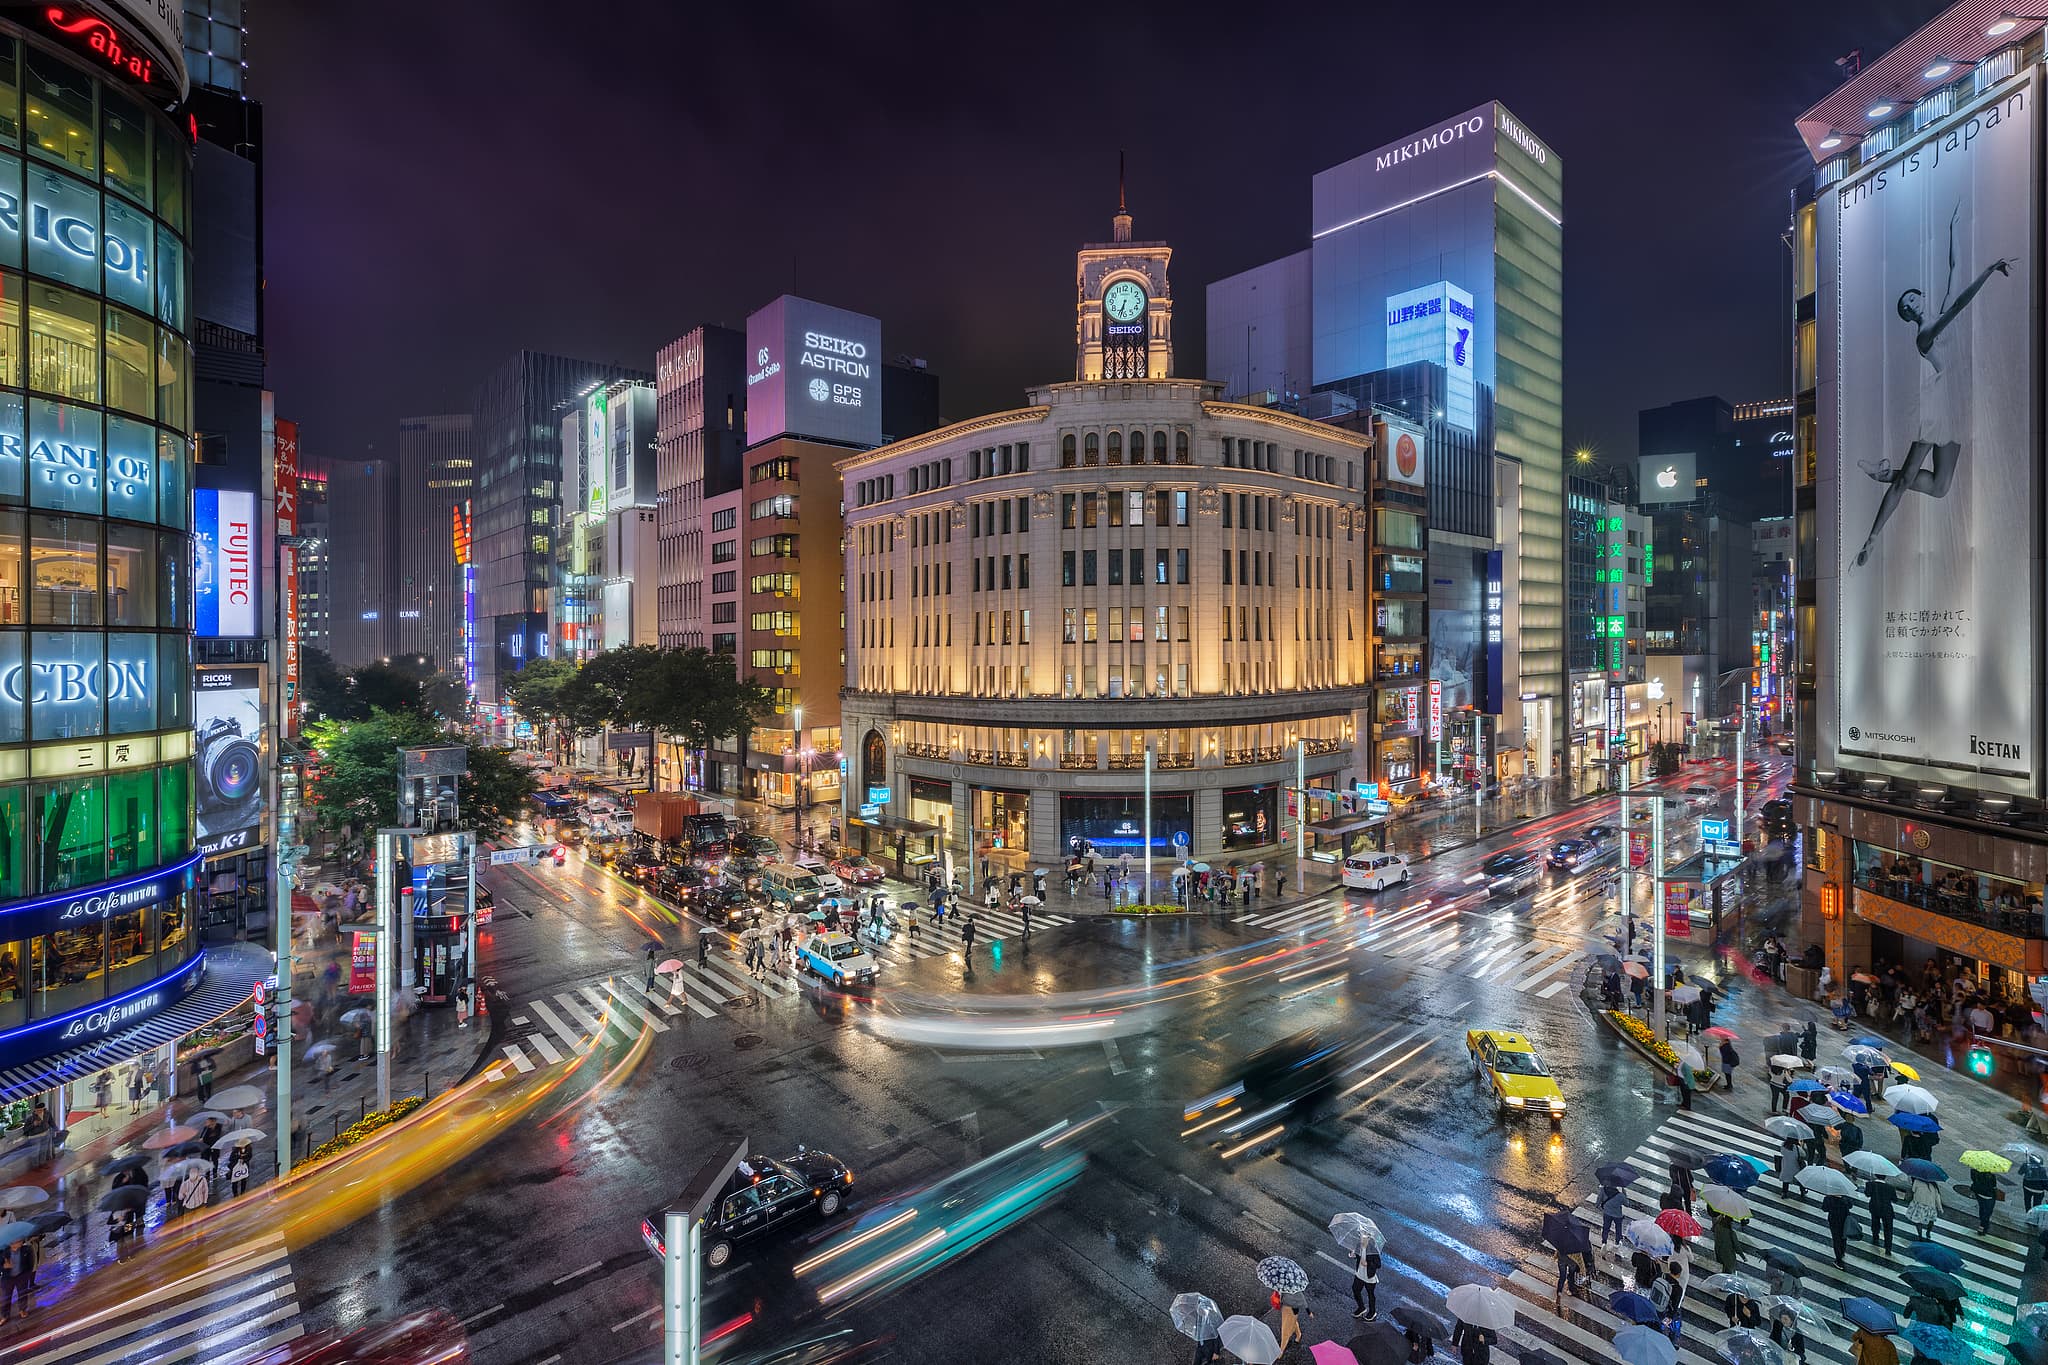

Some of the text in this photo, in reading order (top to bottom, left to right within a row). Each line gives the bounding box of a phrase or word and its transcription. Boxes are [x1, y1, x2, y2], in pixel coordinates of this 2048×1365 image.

[1375, 116, 1483, 172] MIKIMOTO
[1501, 114, 1546, 164] MIKIMOTO
[1841, 90, 2024, 210] this is japan
[1388, 297, 1442, 327] 山野楽器
[1108, 325, 1142, 334] SEIKO
[758, 347, 769, 366] GS
[805, 331, 867, 360] SEIKO
[800, 351, 870, 379] ASTRON
[833, 383, 862, 399] GPS
[833, 395, 862, 407] SOLAR
[222, 521, 248, 605] FUJITEC
[1608, 516, 1623, 583] 教文館
[1488, 581, 1500, 642] 山野楽器
[1885, 609, 1972, 624] 基本に磨かれて、
[1610, 619, 1622, 634] 本
[1885, 626, 1966, 638] 信頼でかがやく。
[4, 662, 148, 703] C'BON
[1864, 732, 1916, 744] MITSUKOSHI
[1969, 735, 2021, 760] ISETAN
[78, 744, 130, 768] 三愛
[220, 831, 247, 850] K-1
[60, 902, 84, 920] Le
[84, 891, 120, 918] Café
[61, 1019, 84, 1040] Le
[86, 1005, 121, 1033] Café
